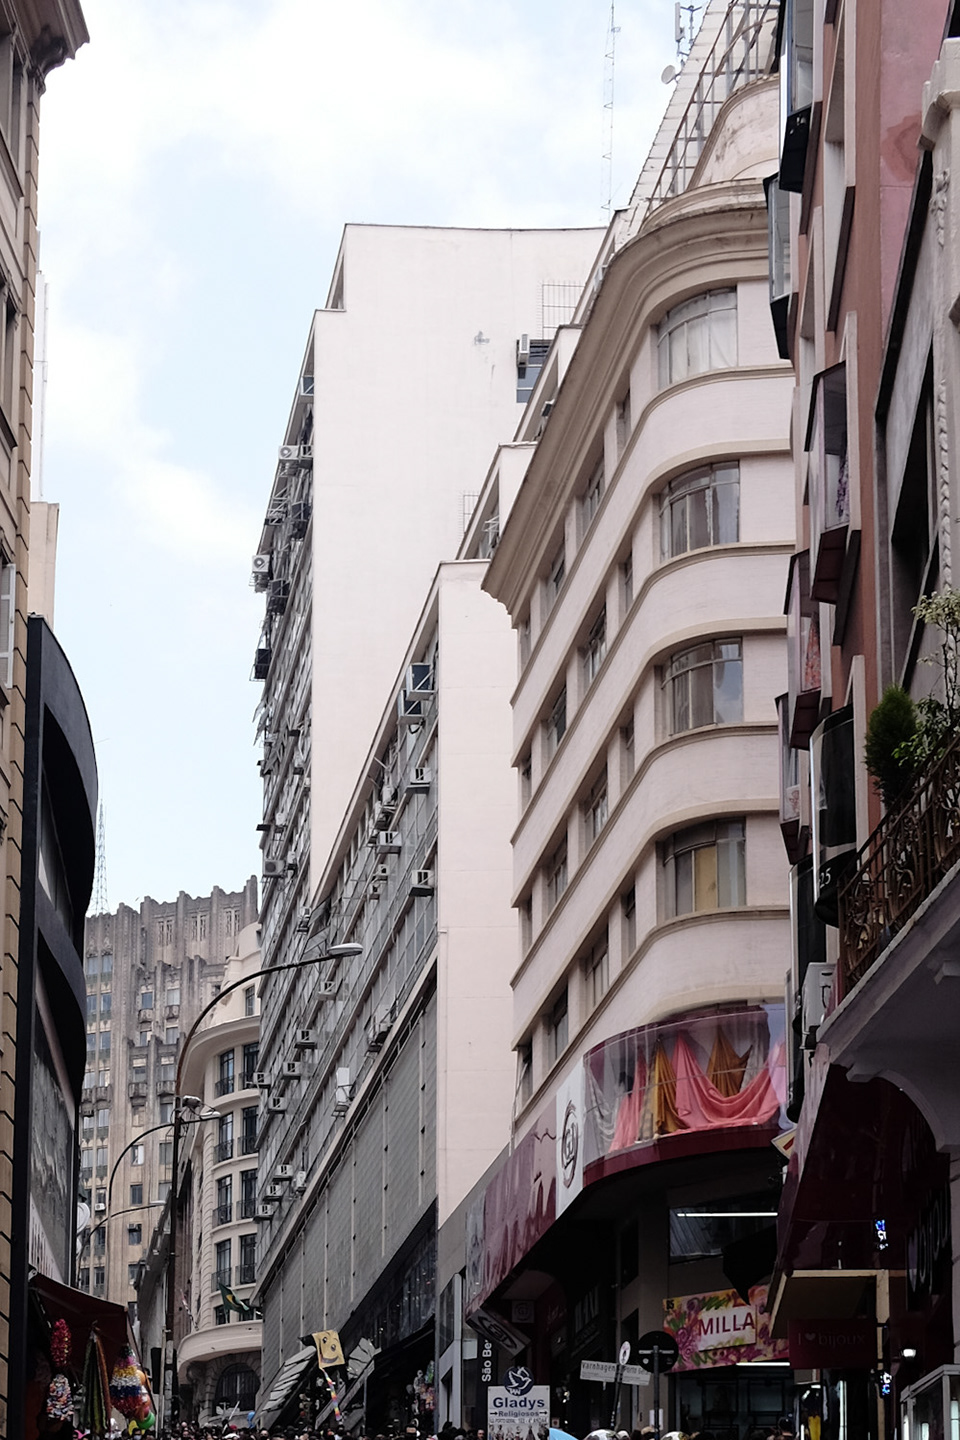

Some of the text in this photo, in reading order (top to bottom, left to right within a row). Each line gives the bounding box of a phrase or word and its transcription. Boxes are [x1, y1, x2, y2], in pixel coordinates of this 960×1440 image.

[698, 1312, 757, 1337] MILLA
[818, 1331, 867, 1349] bijoux
[481, 1339, 493, 1382] São Be
[493, 1397, 545, 1411] Gladys
[498, 1410, 540, 1418] Religiosos
